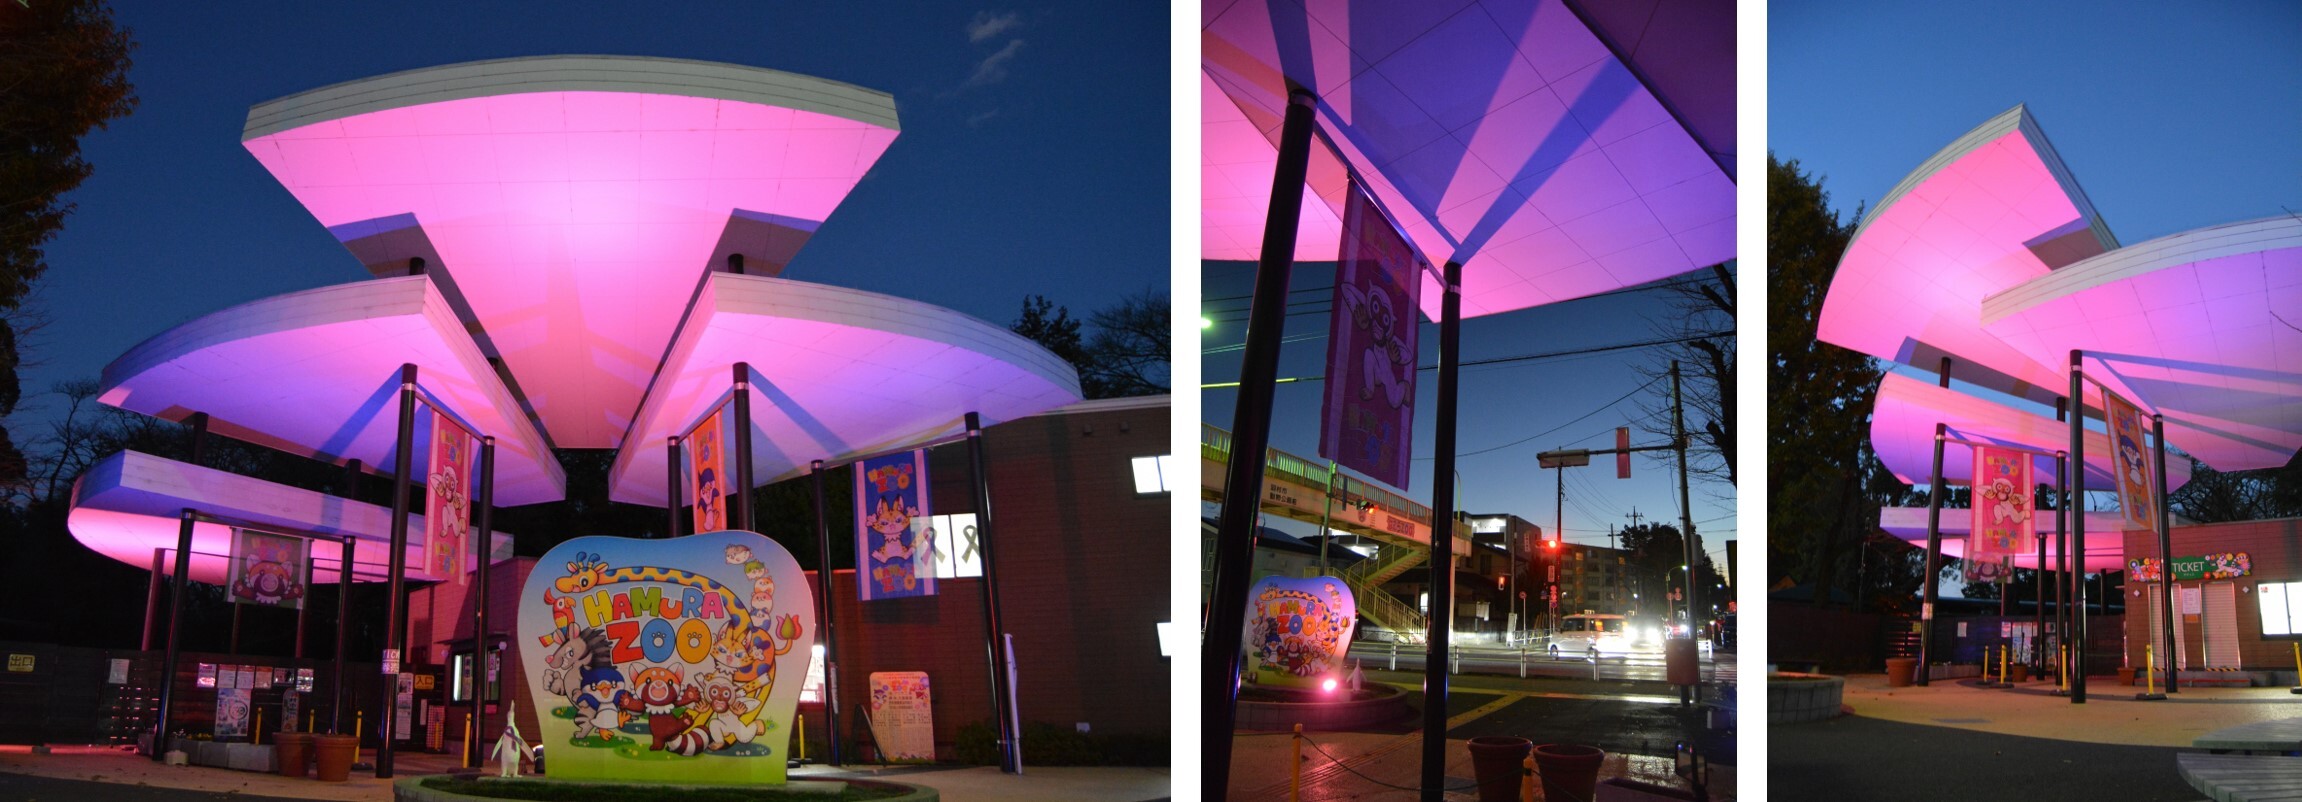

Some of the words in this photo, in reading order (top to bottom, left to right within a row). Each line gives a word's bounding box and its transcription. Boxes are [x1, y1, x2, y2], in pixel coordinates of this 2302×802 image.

[2171, 561, 2205, 573] TICKET
[582, 586, 724, 628] HAMURA
[1269, 600, 1323, 618] HAMURA
[1277, 614, 1316, 636] ZOO
[606, 618, 712, 665] ZOO
[10, 656, 33, 666] 出口
[416, 675, 433, 686] 入口
